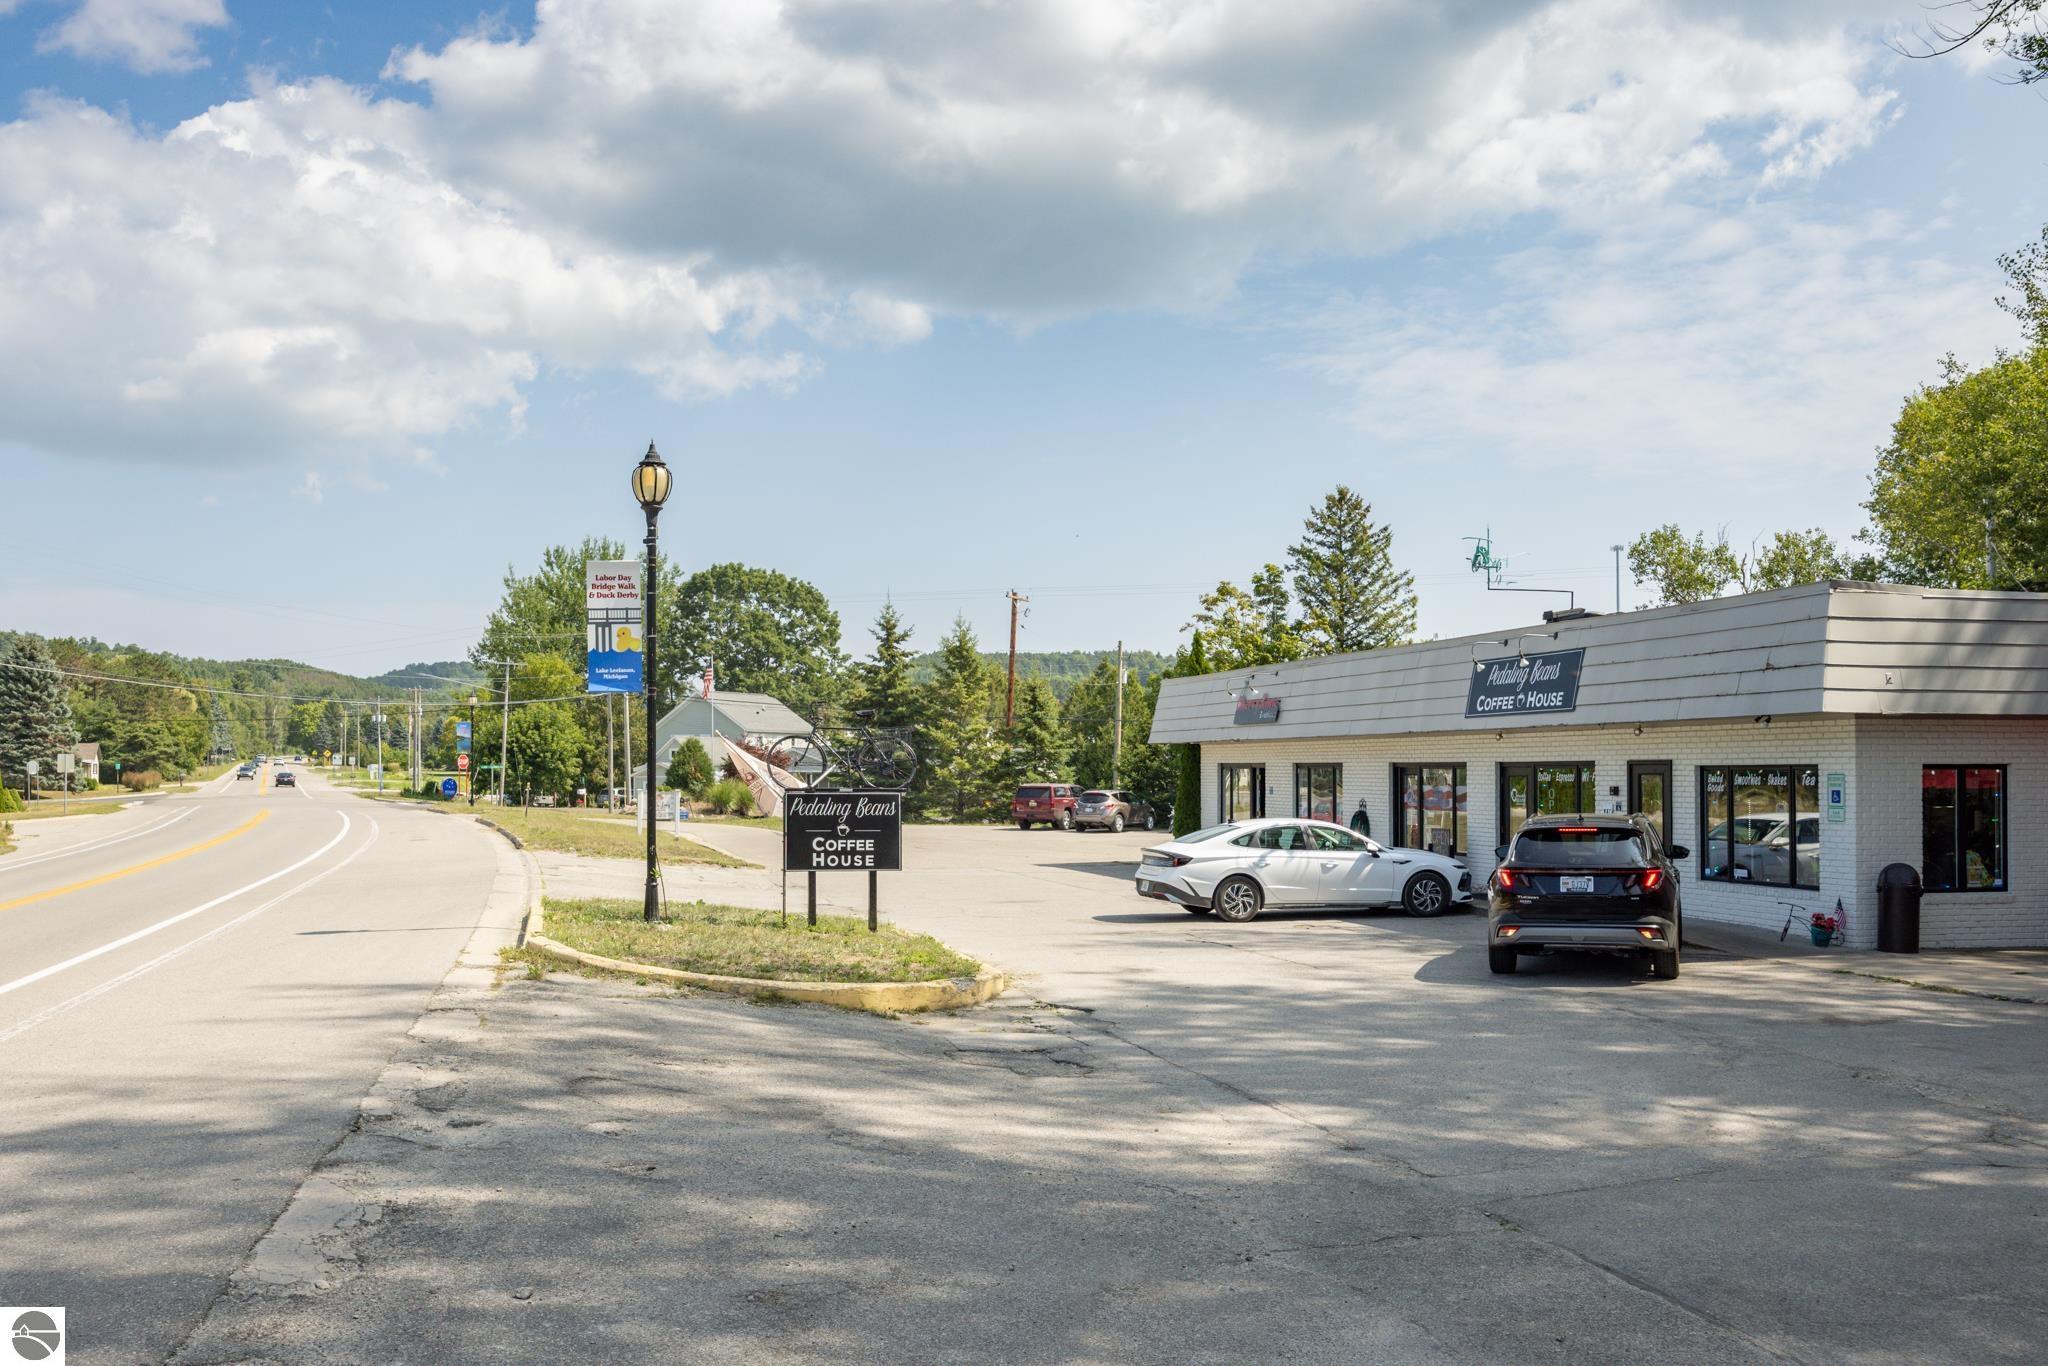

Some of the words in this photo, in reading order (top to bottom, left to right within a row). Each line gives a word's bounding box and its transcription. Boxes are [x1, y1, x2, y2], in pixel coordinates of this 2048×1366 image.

[618, 574, 632, 582] Day
[591, 583, 616, 591] Bridge
[617, 592, 639, 600] Derby
[1487, 662, 1529, 692] Pedaling
[1530, 659, 1561, 685] Beans
[1476, 695, 1515, 711] COFFEE
[1526, 691, 1564, 708] HOUSE
[1734, 773, 1762, 786] Smoothies
[1767, 773, 1787, 786] Shakes
[1801, 773, 1816, 786] Tea
[790, 796, 852, 823] Pedaling
[855, 797, 896, 818] Beans
[812, 837, 875, 851] COFFEE
[812, 852, 875, 867] HOUSE
